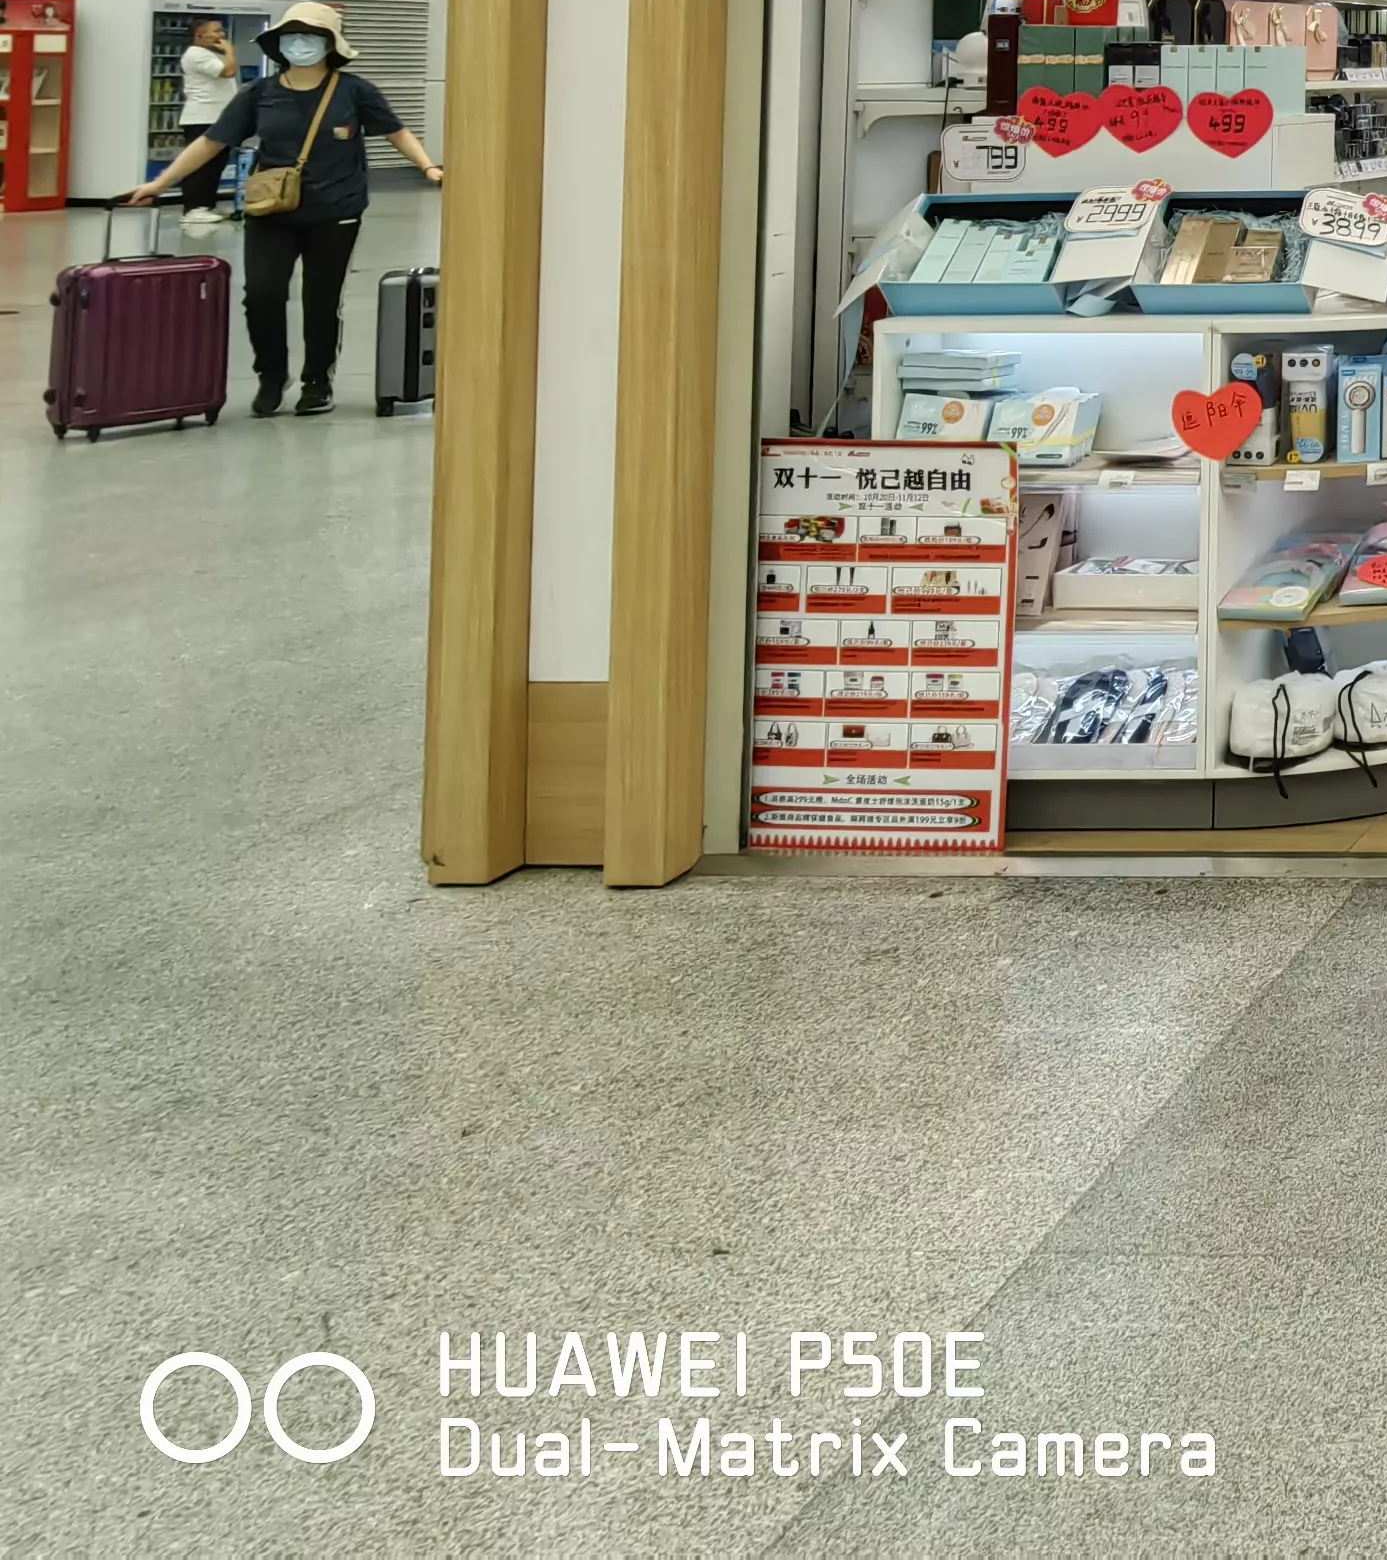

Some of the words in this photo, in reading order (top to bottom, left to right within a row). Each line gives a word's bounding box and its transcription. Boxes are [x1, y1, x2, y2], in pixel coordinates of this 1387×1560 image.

[1209, 112, 1246, 134] 499
[1085, 201, 1148, 223] 2999
[1318, 213, 1383, 240] 3899
[774, 466, 842, 489] 双十一
[856, 467, 972, 491] 悦己越自由
